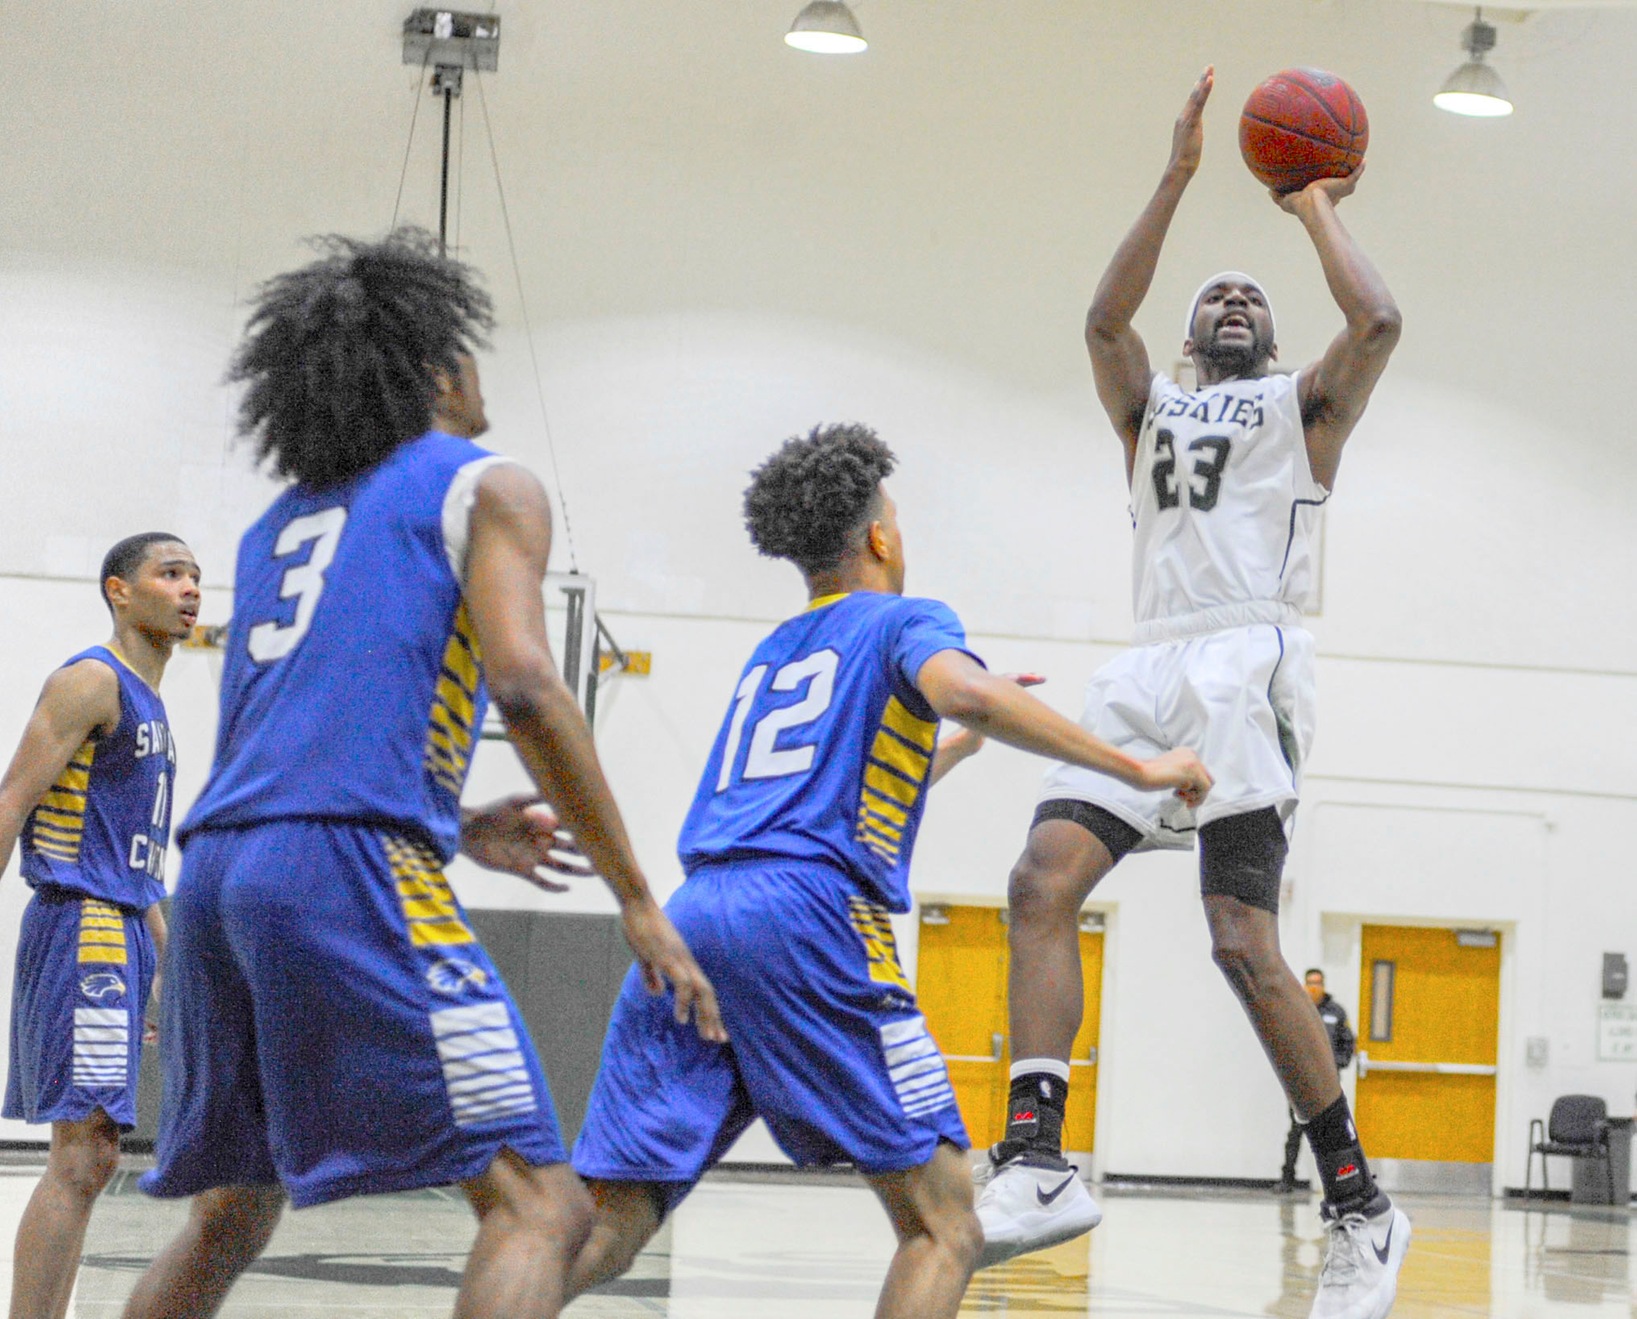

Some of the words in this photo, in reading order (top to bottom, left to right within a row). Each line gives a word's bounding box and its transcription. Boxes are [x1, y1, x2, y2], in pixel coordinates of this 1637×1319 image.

[1152, 428, 1231, 511] 23
[248, 506, 347, 662] 3
[716, 648, 840, 793] 12
